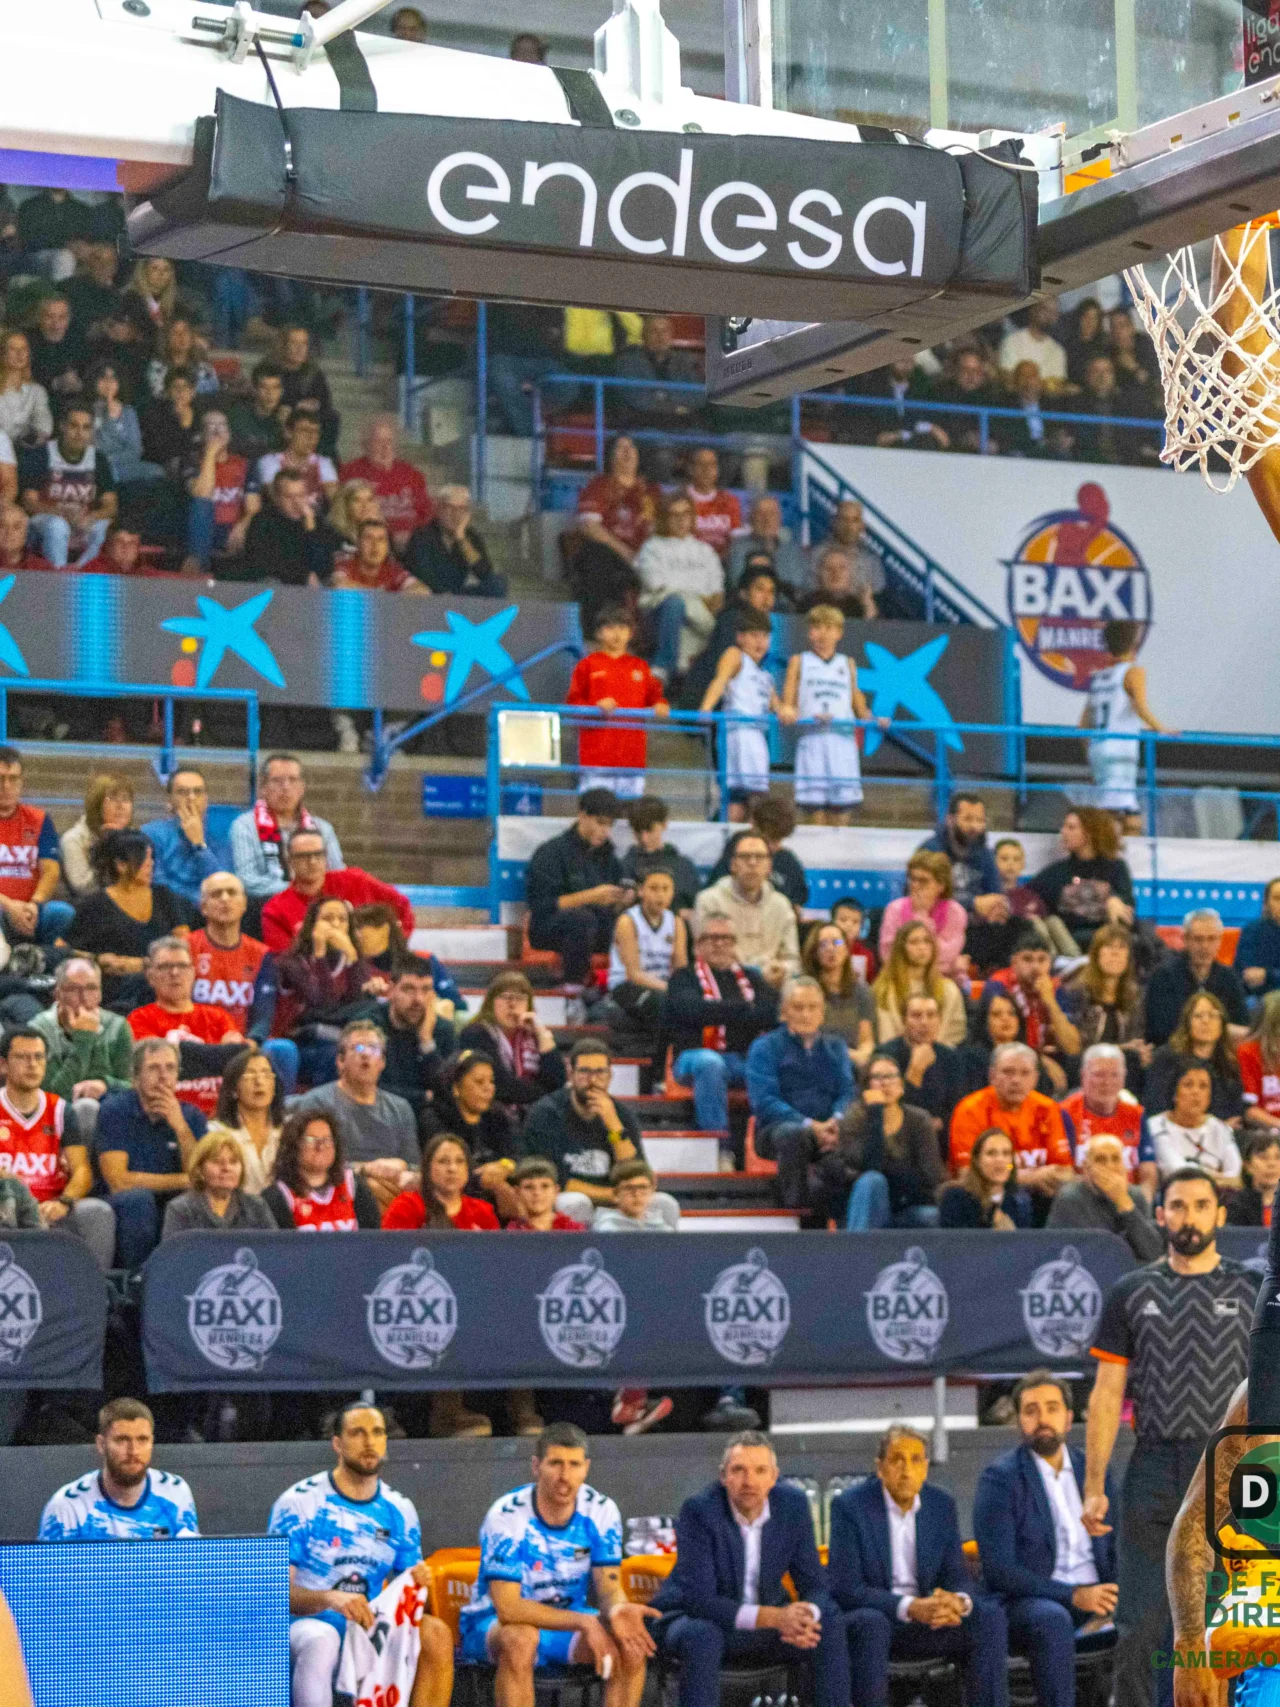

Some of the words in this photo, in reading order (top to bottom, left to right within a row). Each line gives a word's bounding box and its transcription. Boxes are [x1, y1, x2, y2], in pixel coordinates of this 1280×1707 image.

[1247, 12, 1280, 45] liga
[427, 148, 927, 277] endesa
[1013, 565, 1148, 622] BAXI
[1040, 627, 1106, 650] MANRE
[194, 1298, 277, 1326] BAXI
[373, 1297, 452, 1325] BAXI
[545, 1297, 623, 1324] BAXI
[711, 1296, 785, 1322] BAXI
[872, 1294, 944, 1320] BAXI
[1028, 1292, 1097, 1317] BAXI
